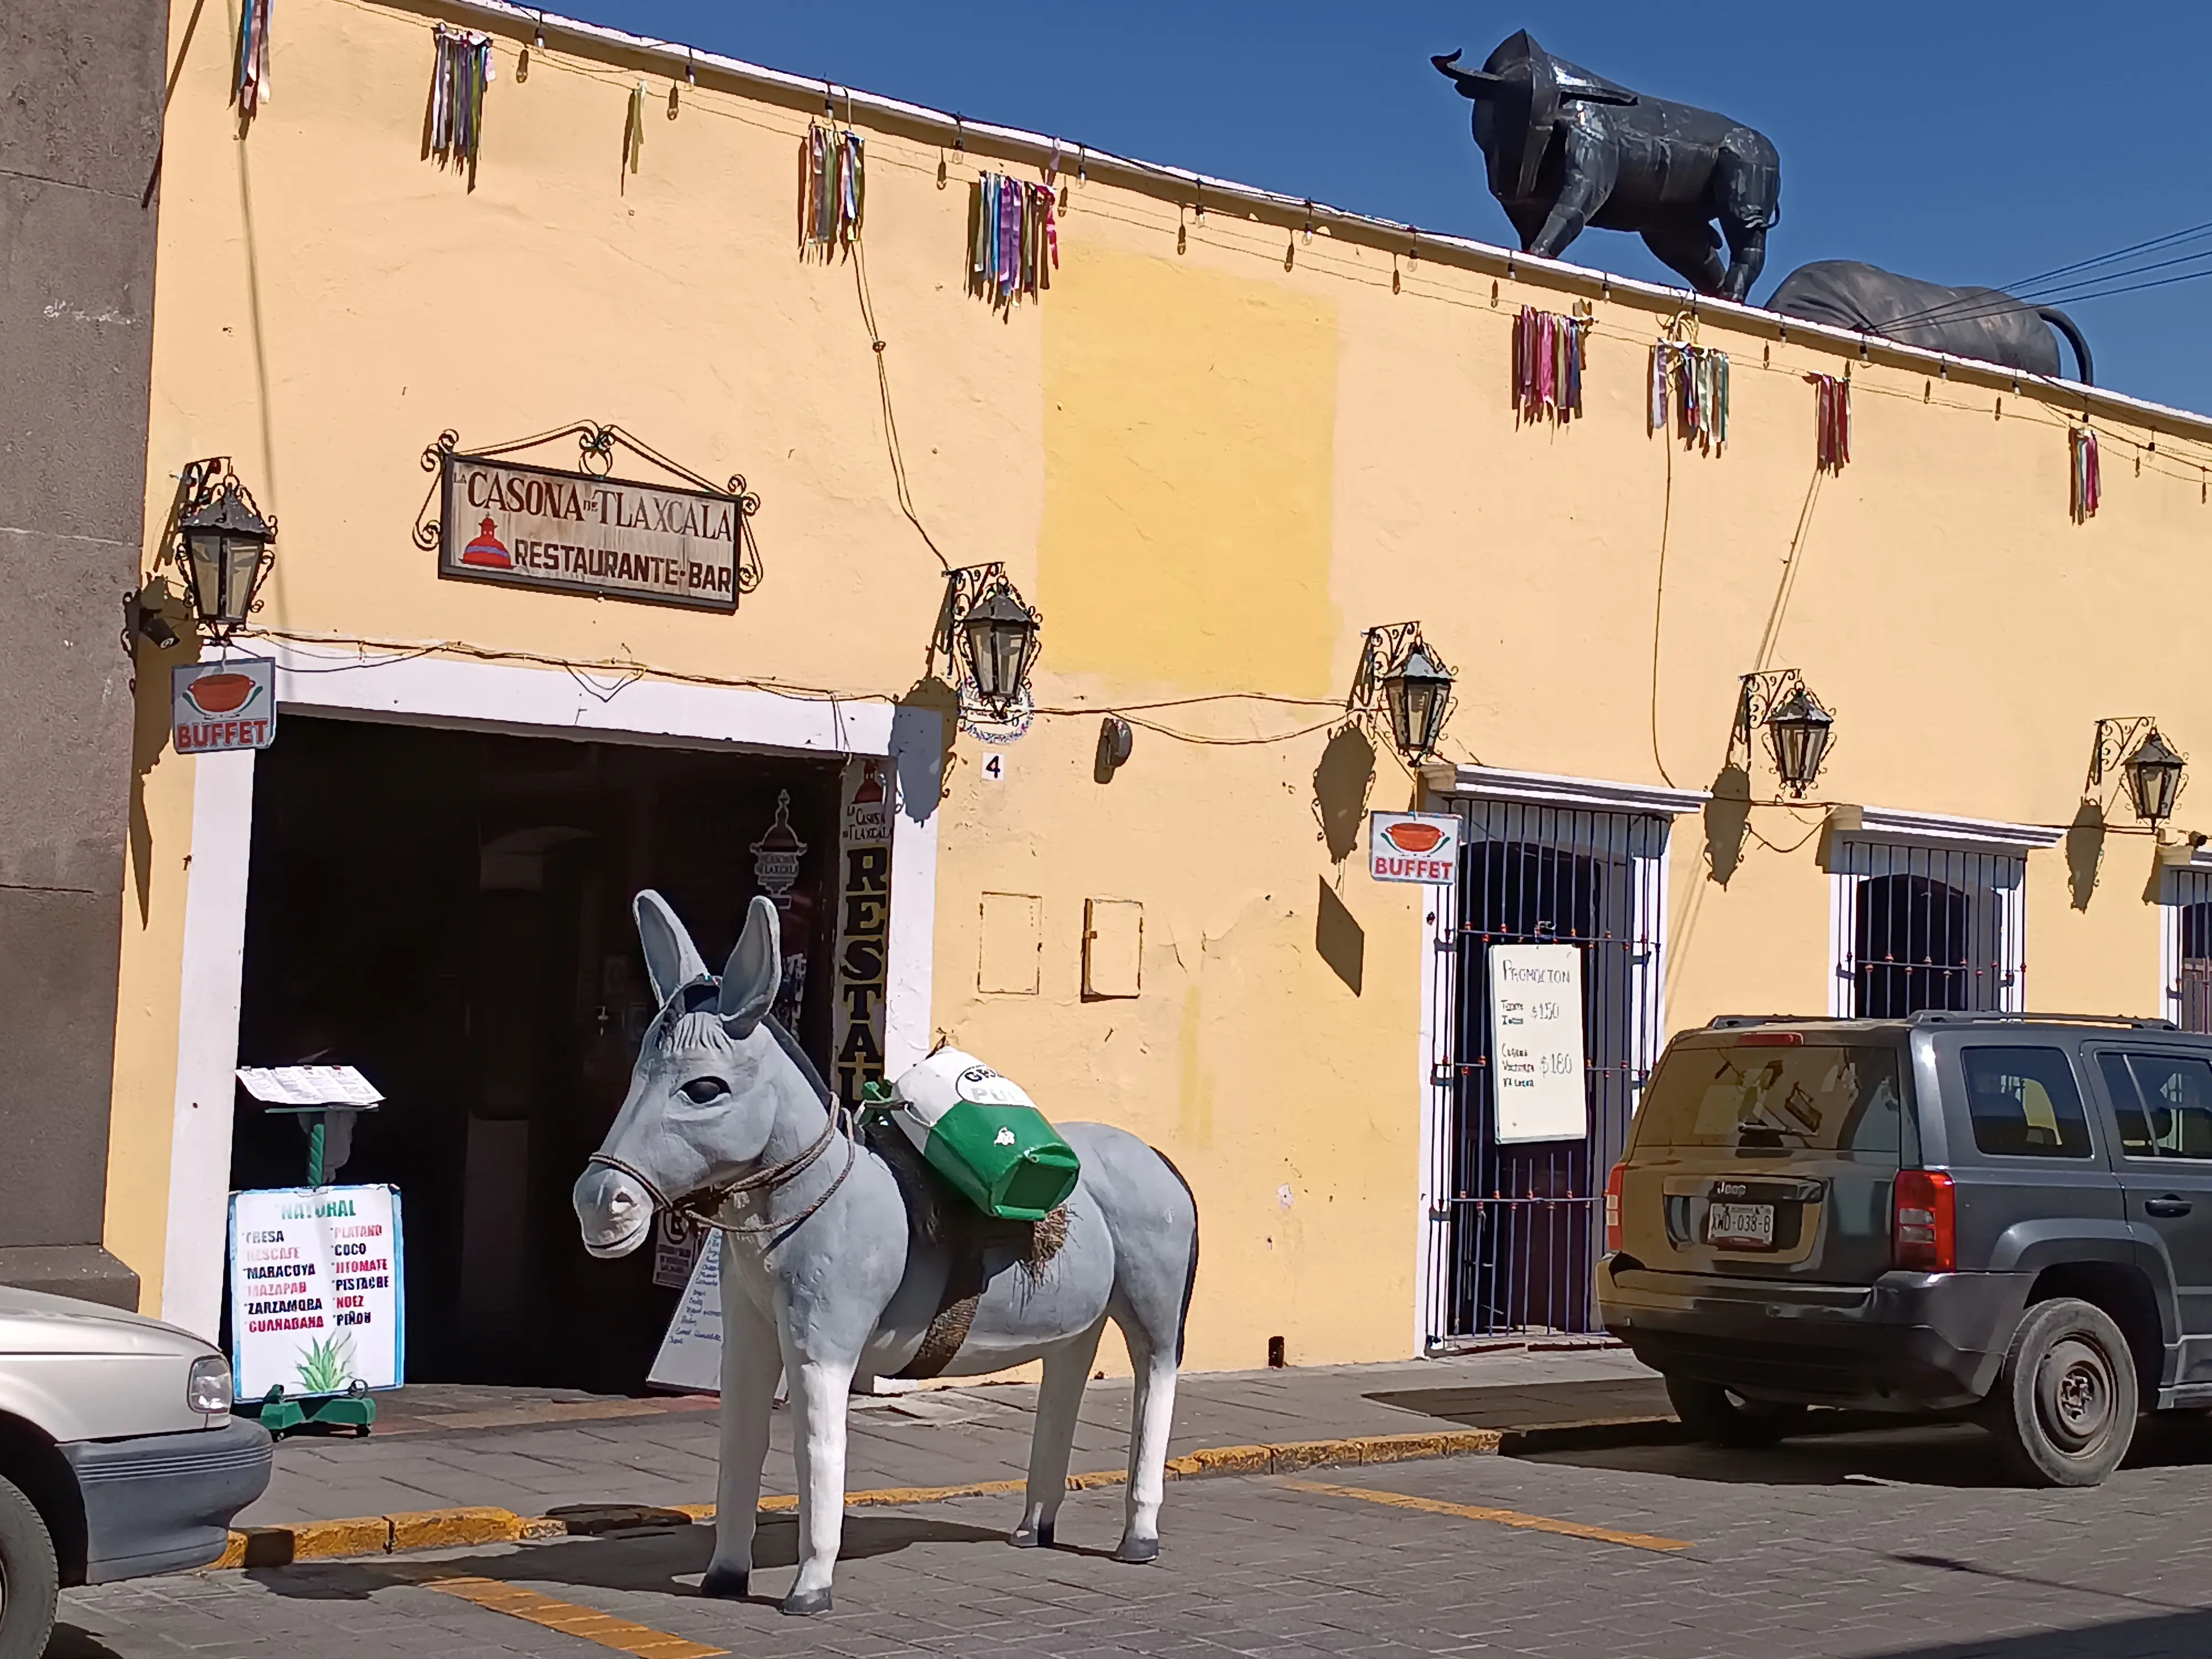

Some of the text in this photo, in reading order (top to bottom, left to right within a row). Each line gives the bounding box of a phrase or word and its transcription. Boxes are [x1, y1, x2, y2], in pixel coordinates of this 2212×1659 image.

[453, 472, 467, 484] LA
[468, 471, 586, 521] CASONA
[592, 489, 733, 542] TLAXCALA
[177, 719, 268, 748] BUFFET
[985, 755, 1001, 779] 4
[1375, 857, 1453, 880] BUFFET
[1531, 1001, 1559, 1020] $150
[281, 1199, 357, 1220] NATURAL
[335, 1243, 367, 1256] COCO
[336, 1275, 389, 1291] PISTACHE
[248, 1298, 323, 1315] ZARZAMORA
[336, 1295, 364, 1309] NUEZ
[249, 1316, 325, 1333] GUANABANA
[336, 1310, 371, 1326] PIÑON
